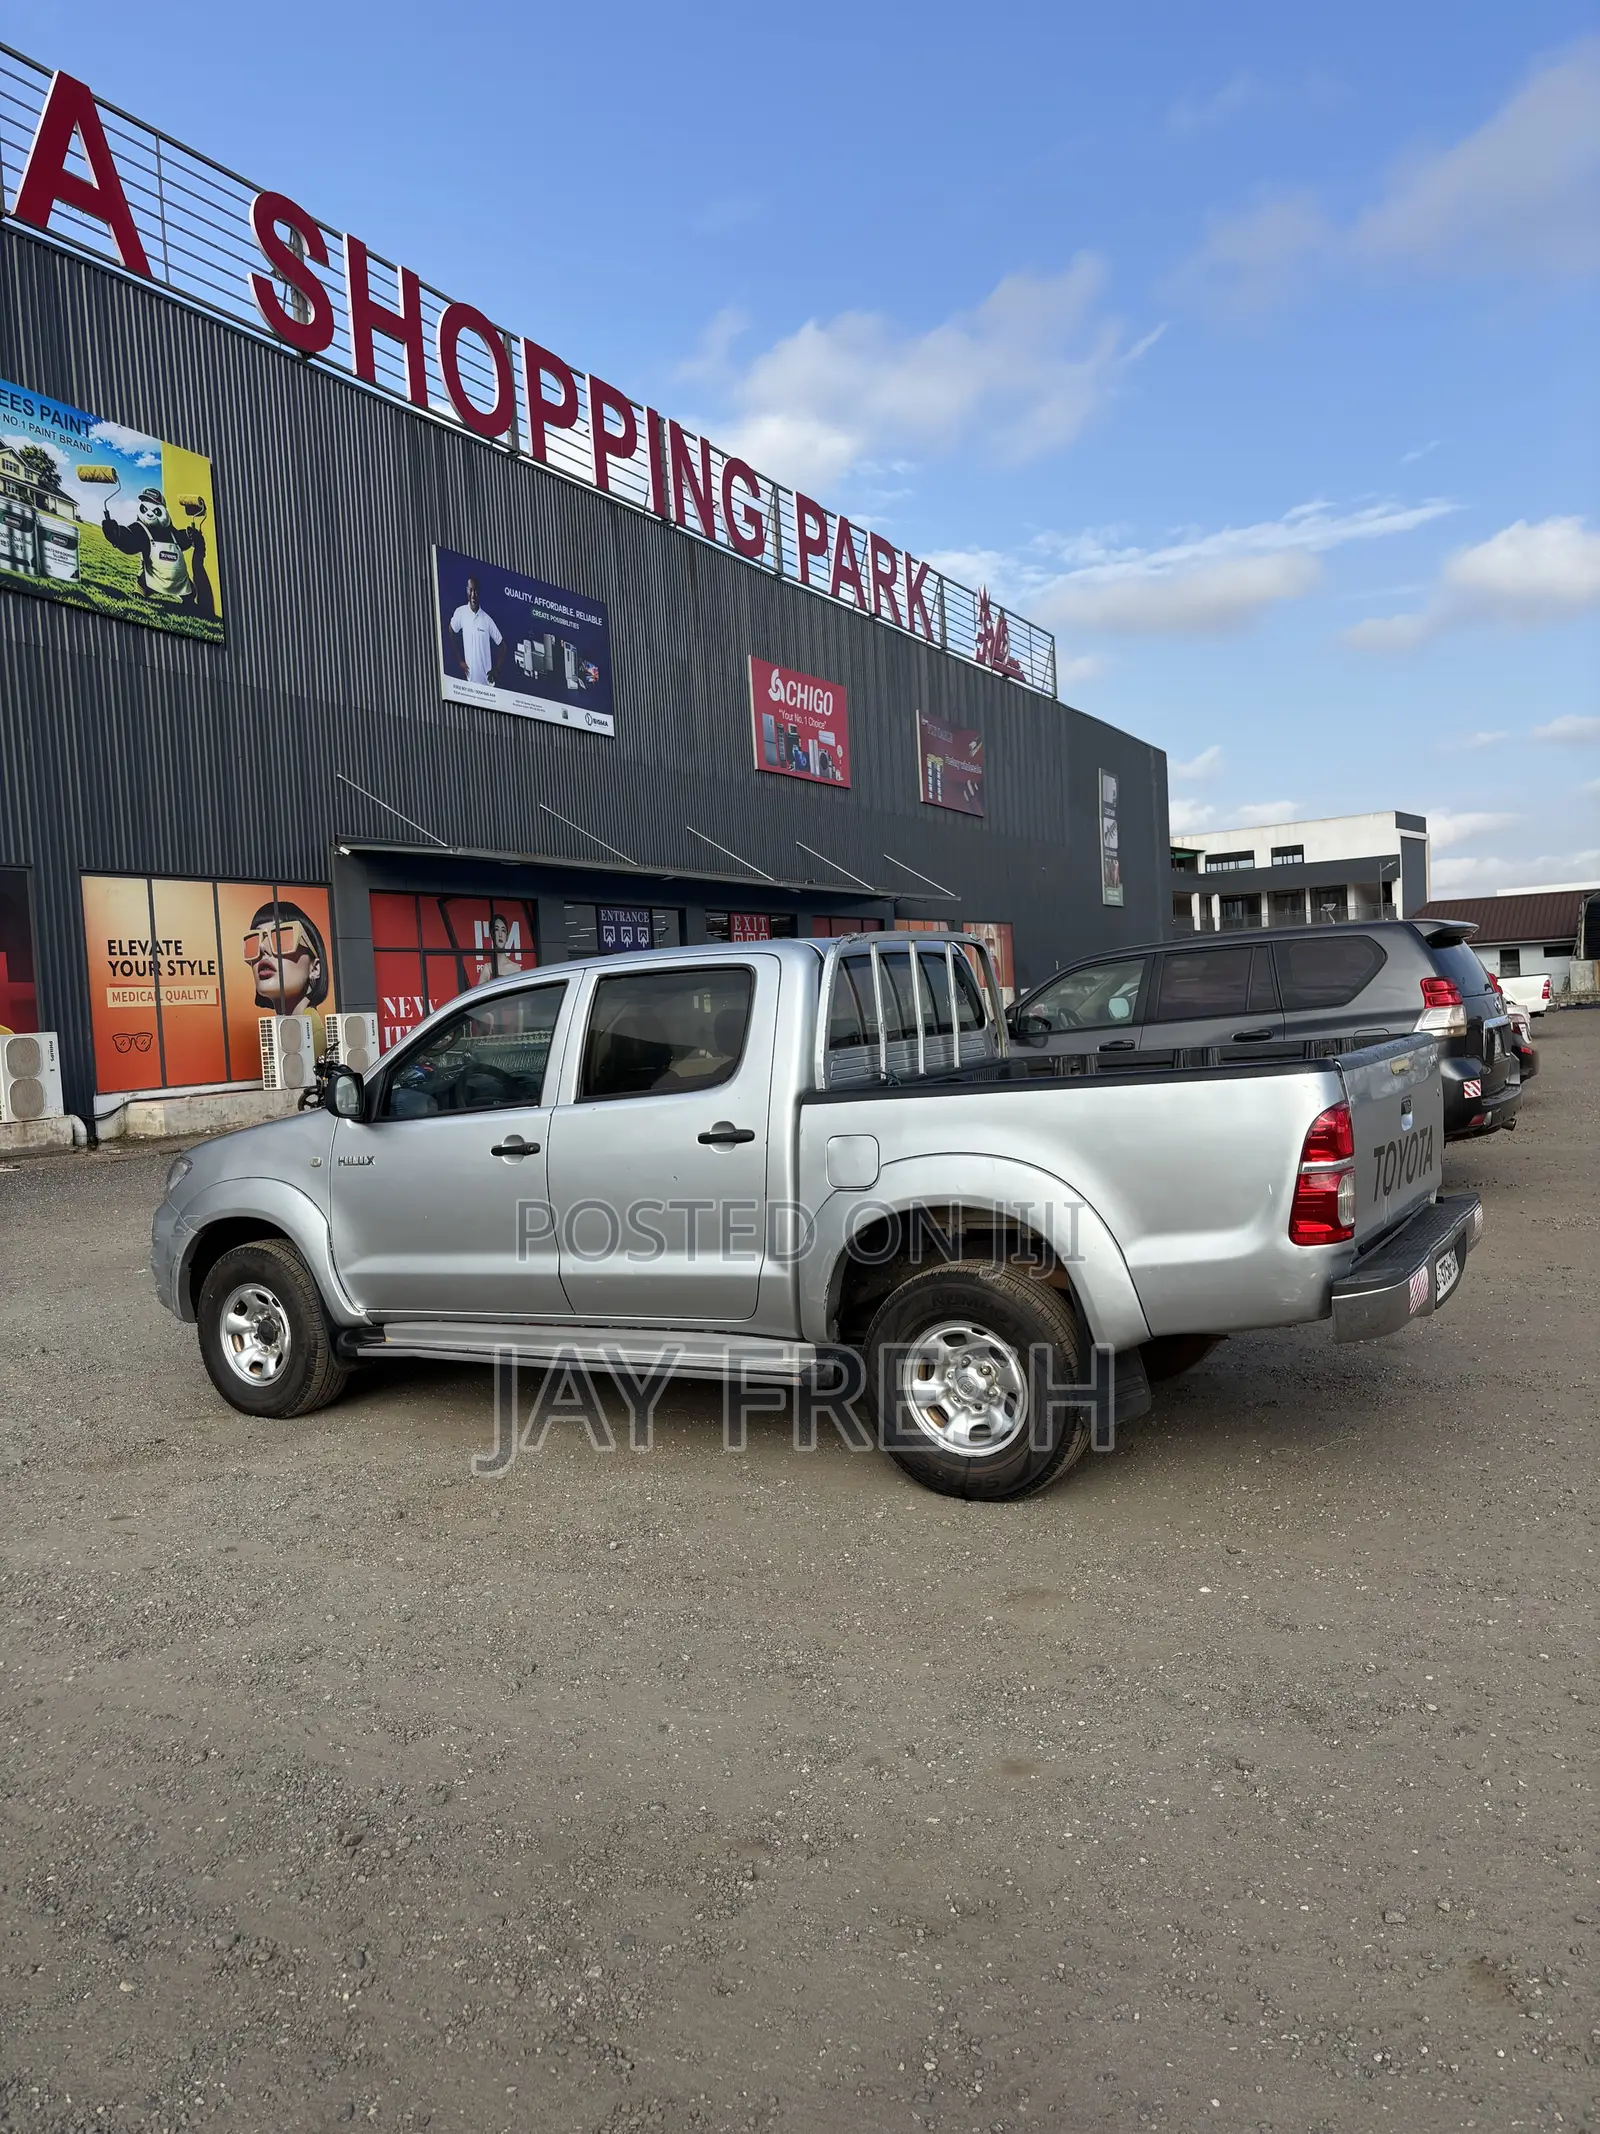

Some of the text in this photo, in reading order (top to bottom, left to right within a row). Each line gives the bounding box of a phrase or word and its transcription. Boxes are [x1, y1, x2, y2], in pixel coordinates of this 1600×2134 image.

[9, 69, 935, 642] A SHOPPING PARK
[40, 404, 94, 439] PAINT
[3, 413, 93, 454] NO.1 PAINT BRAND
[532, 610, 550, 621] CREATE
[576, 610, 603, 626] RELIABLE
[786, 680, 833, 716] CHIGO
[601, 910, 650, 923] ENTRANCE
[734, 916, 767, 932] EXIT
[107, 940, 183, 956] ELEVATE
[107, 960, 216, 977] YOUR STYLE
[165, 990, 209, 1003] QUALITY
[338, 1156, 375, 1166] HILUX
[1374, 1125, 1432, 1202] TOYOTA
